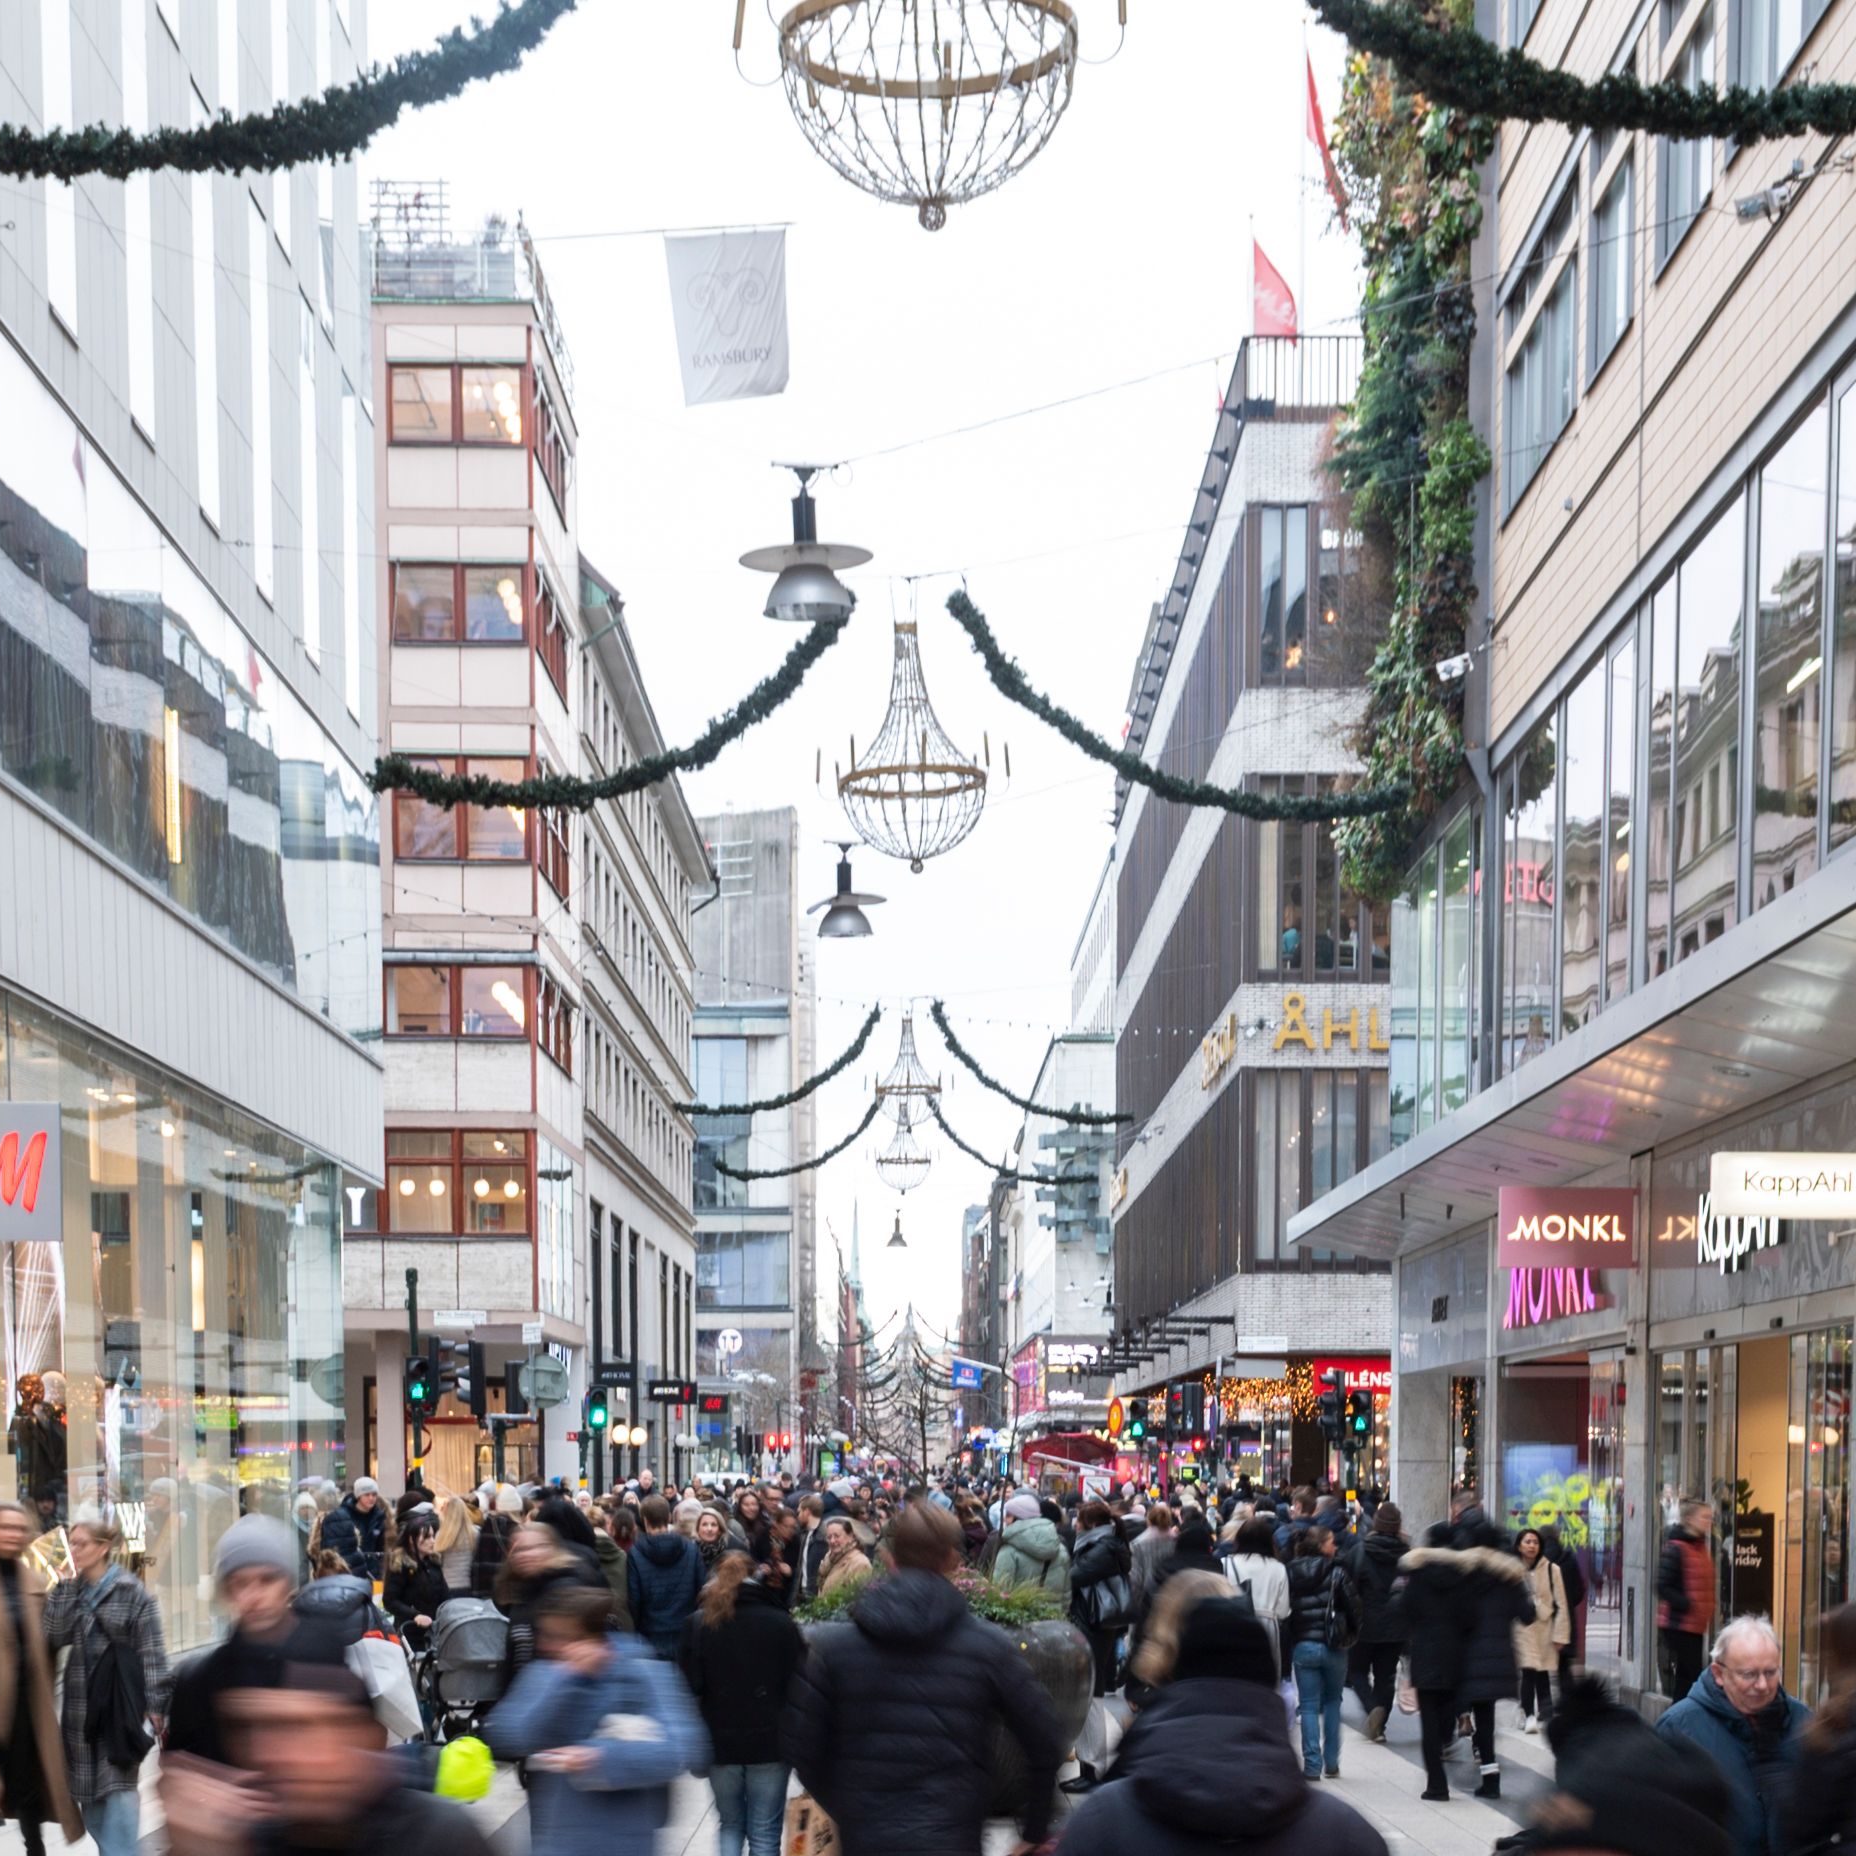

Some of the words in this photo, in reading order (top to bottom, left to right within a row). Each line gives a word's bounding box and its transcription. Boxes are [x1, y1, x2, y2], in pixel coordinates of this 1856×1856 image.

[692, 346, 772, 369] RAMSBURY
[1744, 1170, 1852, 1197] KappAhl
[1507, 1214, 1626, 1242] MONKI
[1327, 1367, 1393, 1387] LÉNS
[1735, 1543, 1758, 1556] lack
[1735, 1556, 1763, 1569] riday
